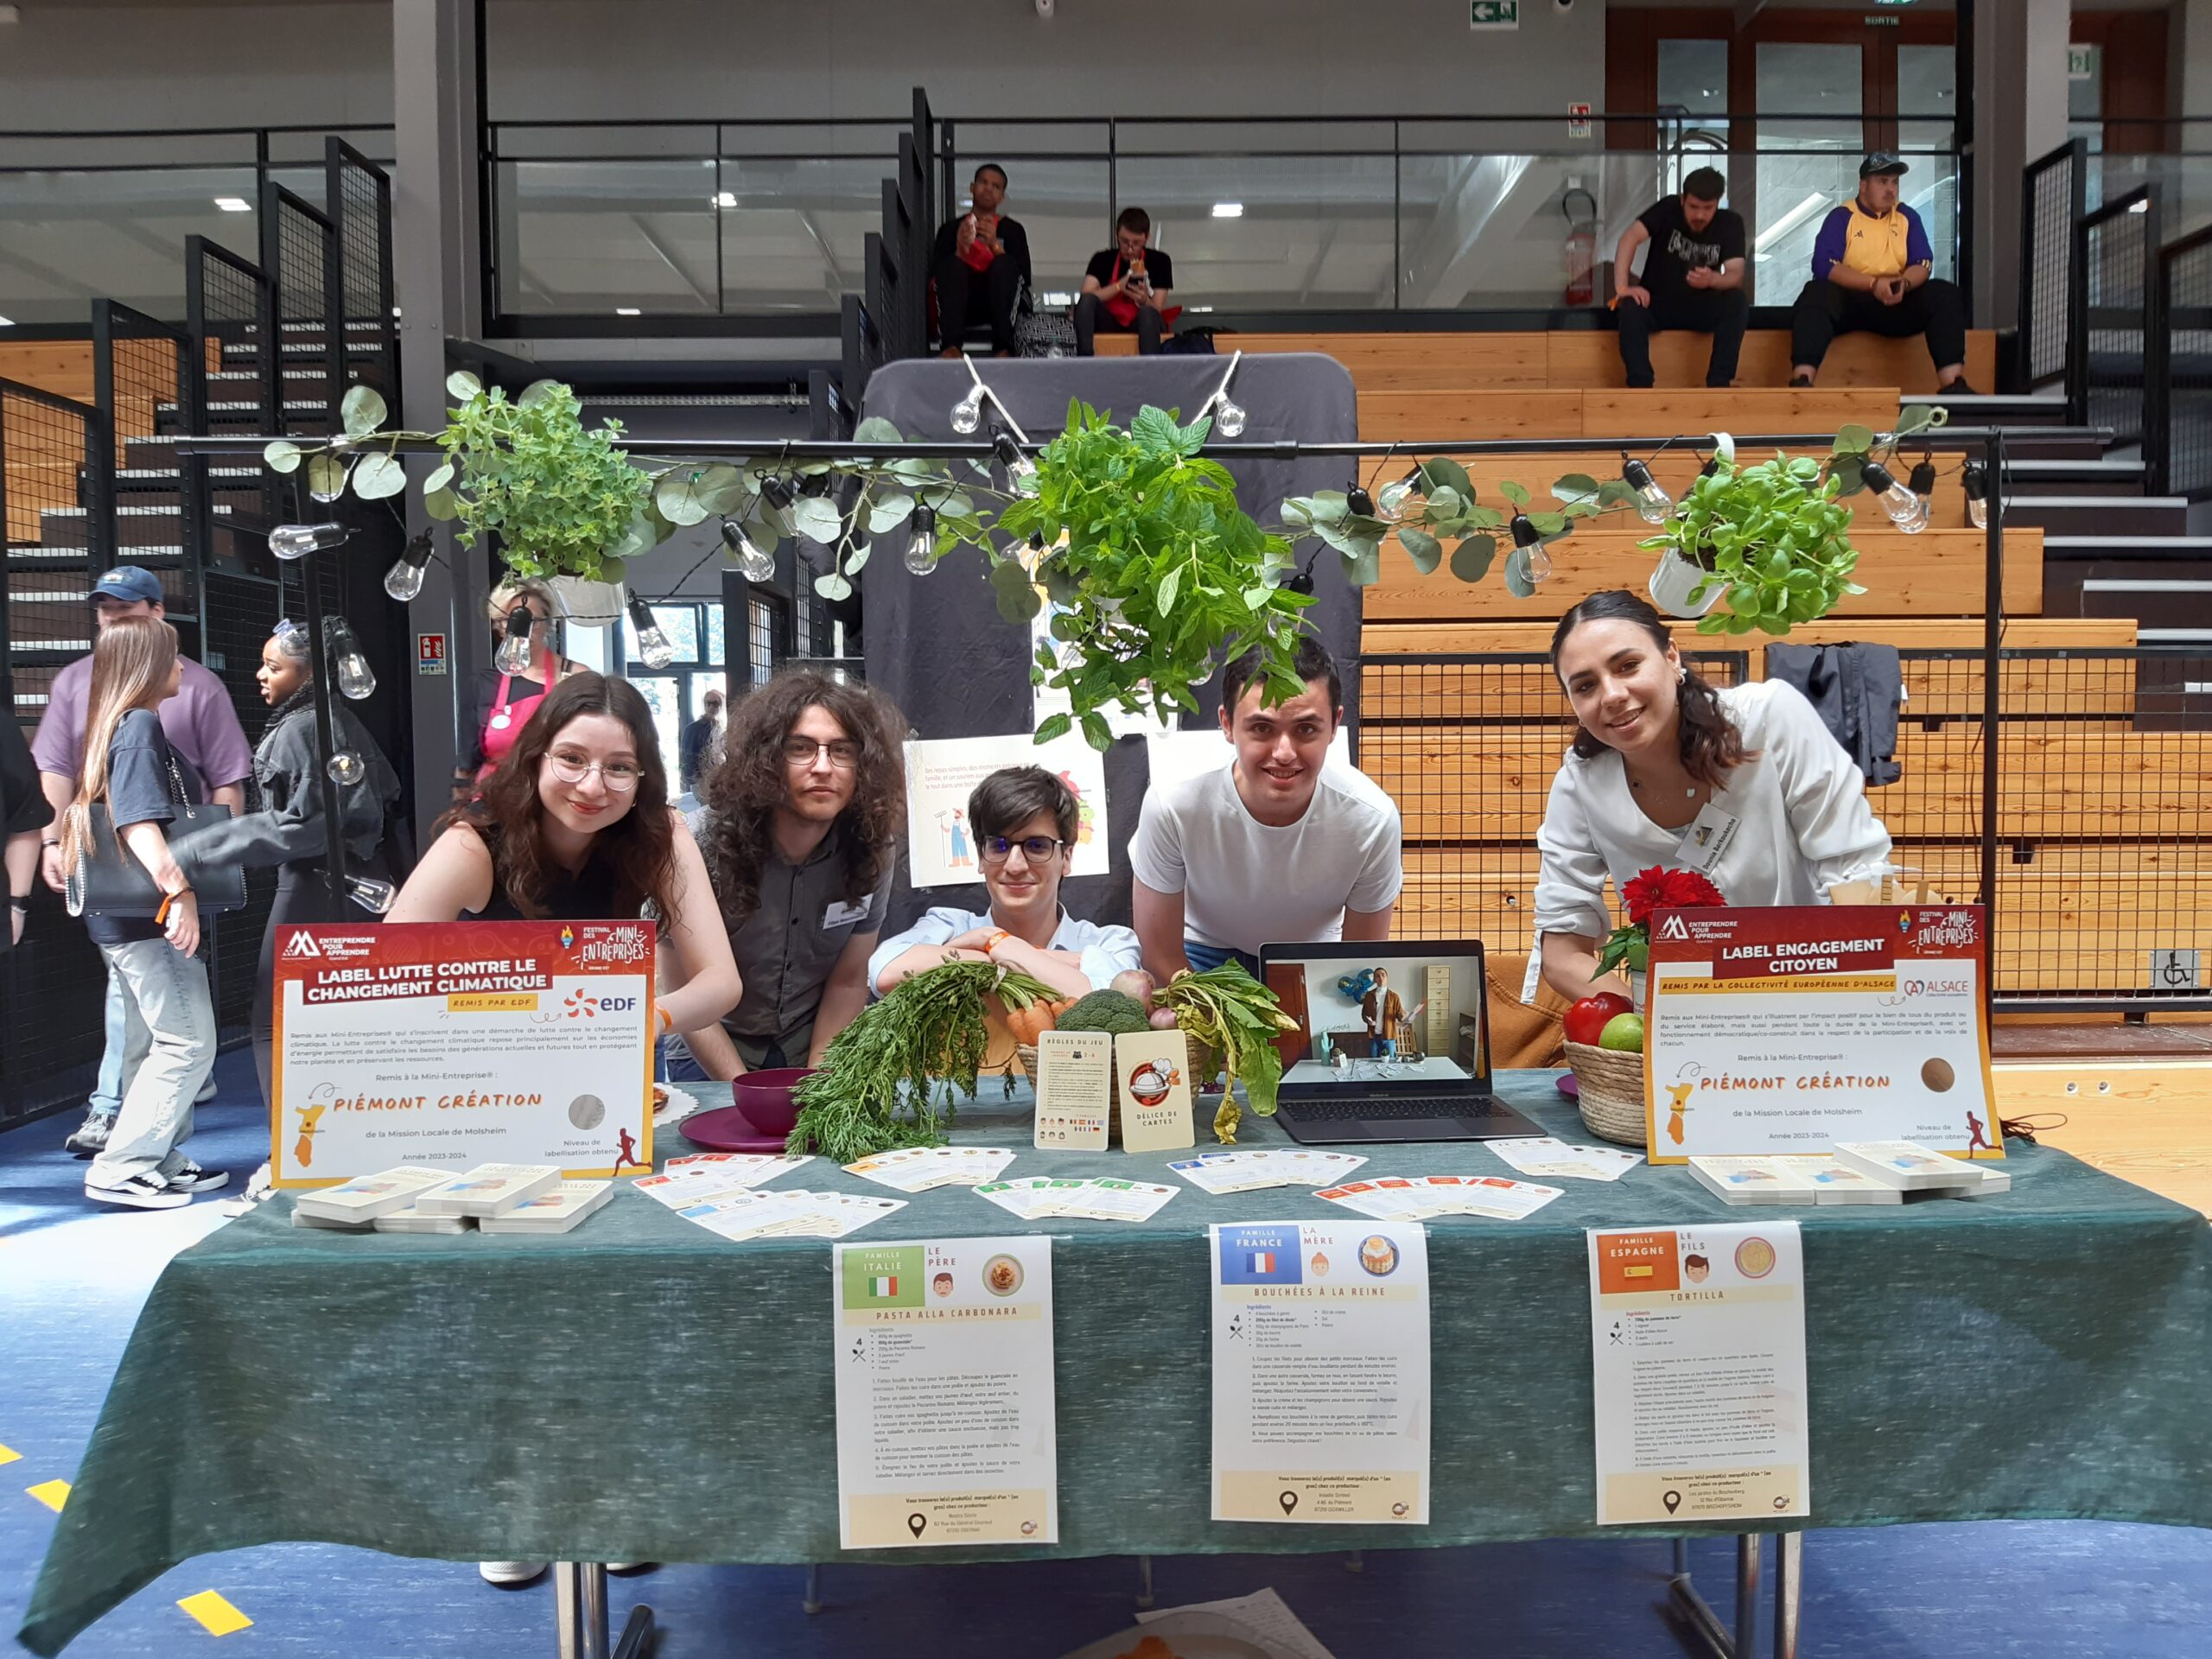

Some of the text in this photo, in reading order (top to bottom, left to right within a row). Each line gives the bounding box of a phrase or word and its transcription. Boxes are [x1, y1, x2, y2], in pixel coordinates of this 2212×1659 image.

[1918, 925, 1974, 948] ENTREPRISES
[583, 939, 644, 963] ENTREPRISES
[1723, 938, 1885, 960] LABEL ENGAGEMENT
[1769, 957, 1838, 973] CITOYEN
[318, 958, 537, 984] LABEL LUTTE CONTRE LE
[307, 975, 547, 1001] CHANGEMENT CLIMATIQUE
[1727, 980, 1789, 989] COLLECTIVITÉ
[1793, 976, 1849, 988] EUROPÉENNE
[1926, 981, 1968, 993] ALSACE
[404, 1073, 410, 1082] à
[1700, 1071, 1891, 1090] PIÉMONT CRÉATION
[334, 1090, 543, 1112] PIÉMONT CRÉATION
[1137, 1111, 1163, 1120] DÉLICE
[1142, 1118, 1173, 1127] CARTES
[365, 1130, 377, 1139] de
[388, 1128, 420, 1138] Mission
[422, 1128, 449, 1137] Locale
[465, 1127, 506, 1135] Molsheim
[1236, 1238, 1283, 1248] FRANCE
[1304, 1236, 1334, 1245] MÈRE
[928, 1247, 941, 1255] LE
[1610, 1247, 1664, 1258] ESPAGNE
[1681, 1243, 1706, 1251] FILS
[864, 1262, 902, 1272] ITALIE
[928, 1256, 957, 1267] PÈRE
[1254, 1286, 1386, 1296] BOUCHÉES À LA REINE
[1670, 1291, 1725, 1301] TORTILLA
[876, 1307, 1018, 1320] PASTA ALLA CARBONARA
[855, 1338, 862, 1346] 4
